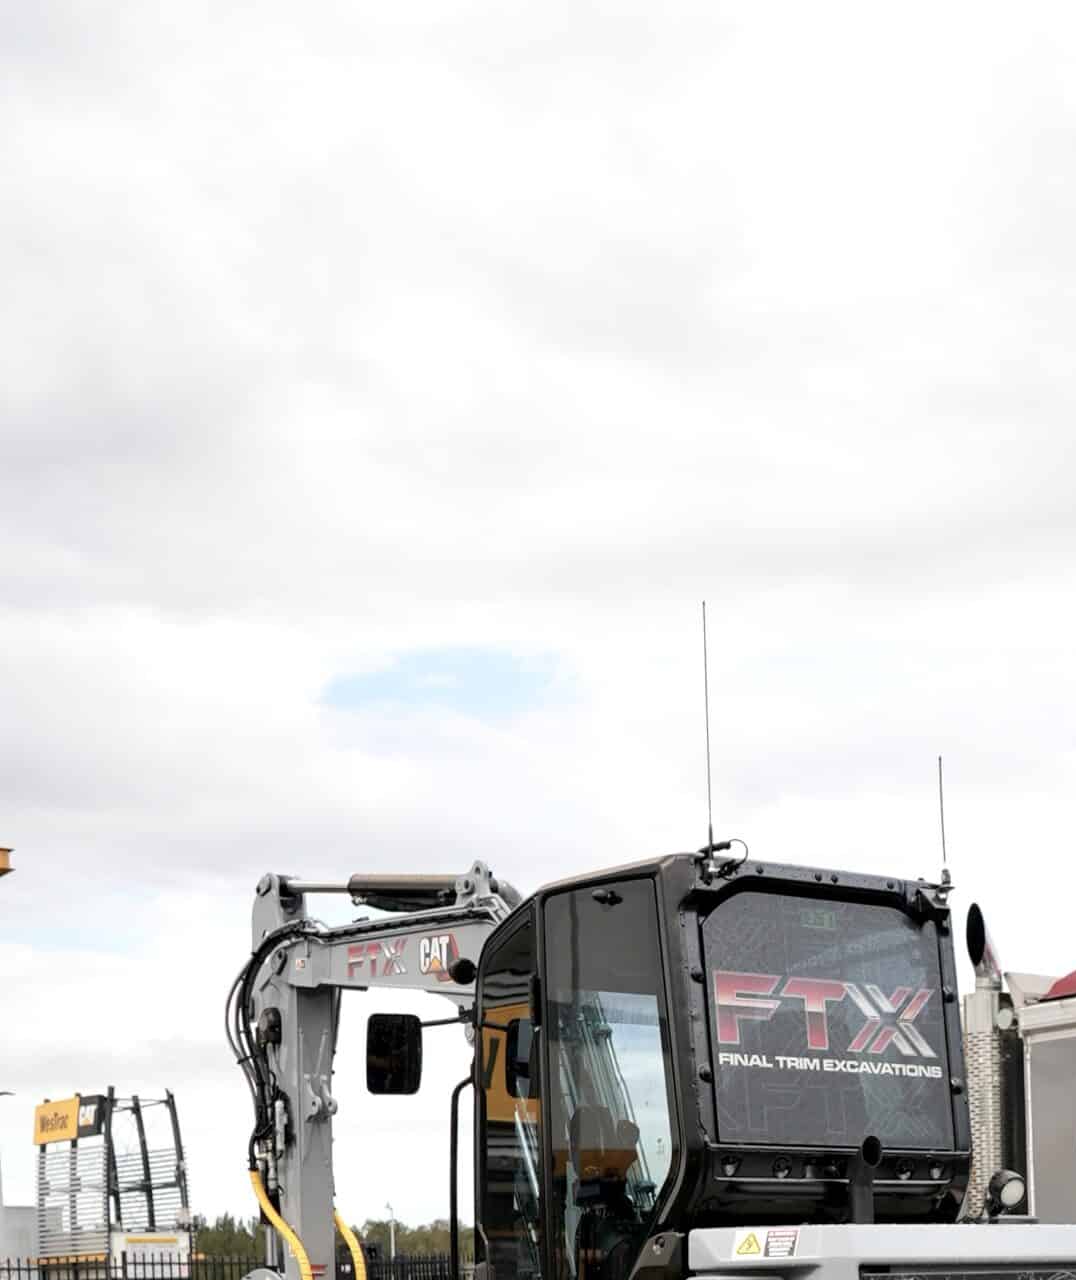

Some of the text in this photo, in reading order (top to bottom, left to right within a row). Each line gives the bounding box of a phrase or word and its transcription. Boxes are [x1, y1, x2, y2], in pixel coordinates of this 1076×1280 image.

[347, 938, 407, 977] FTX
[419, 934, 450, 975] CAT
[713, 970, 938, 1057] FTX
[718, 1053, 943, 1079] FINAL TRIM EXCAVATIONS
